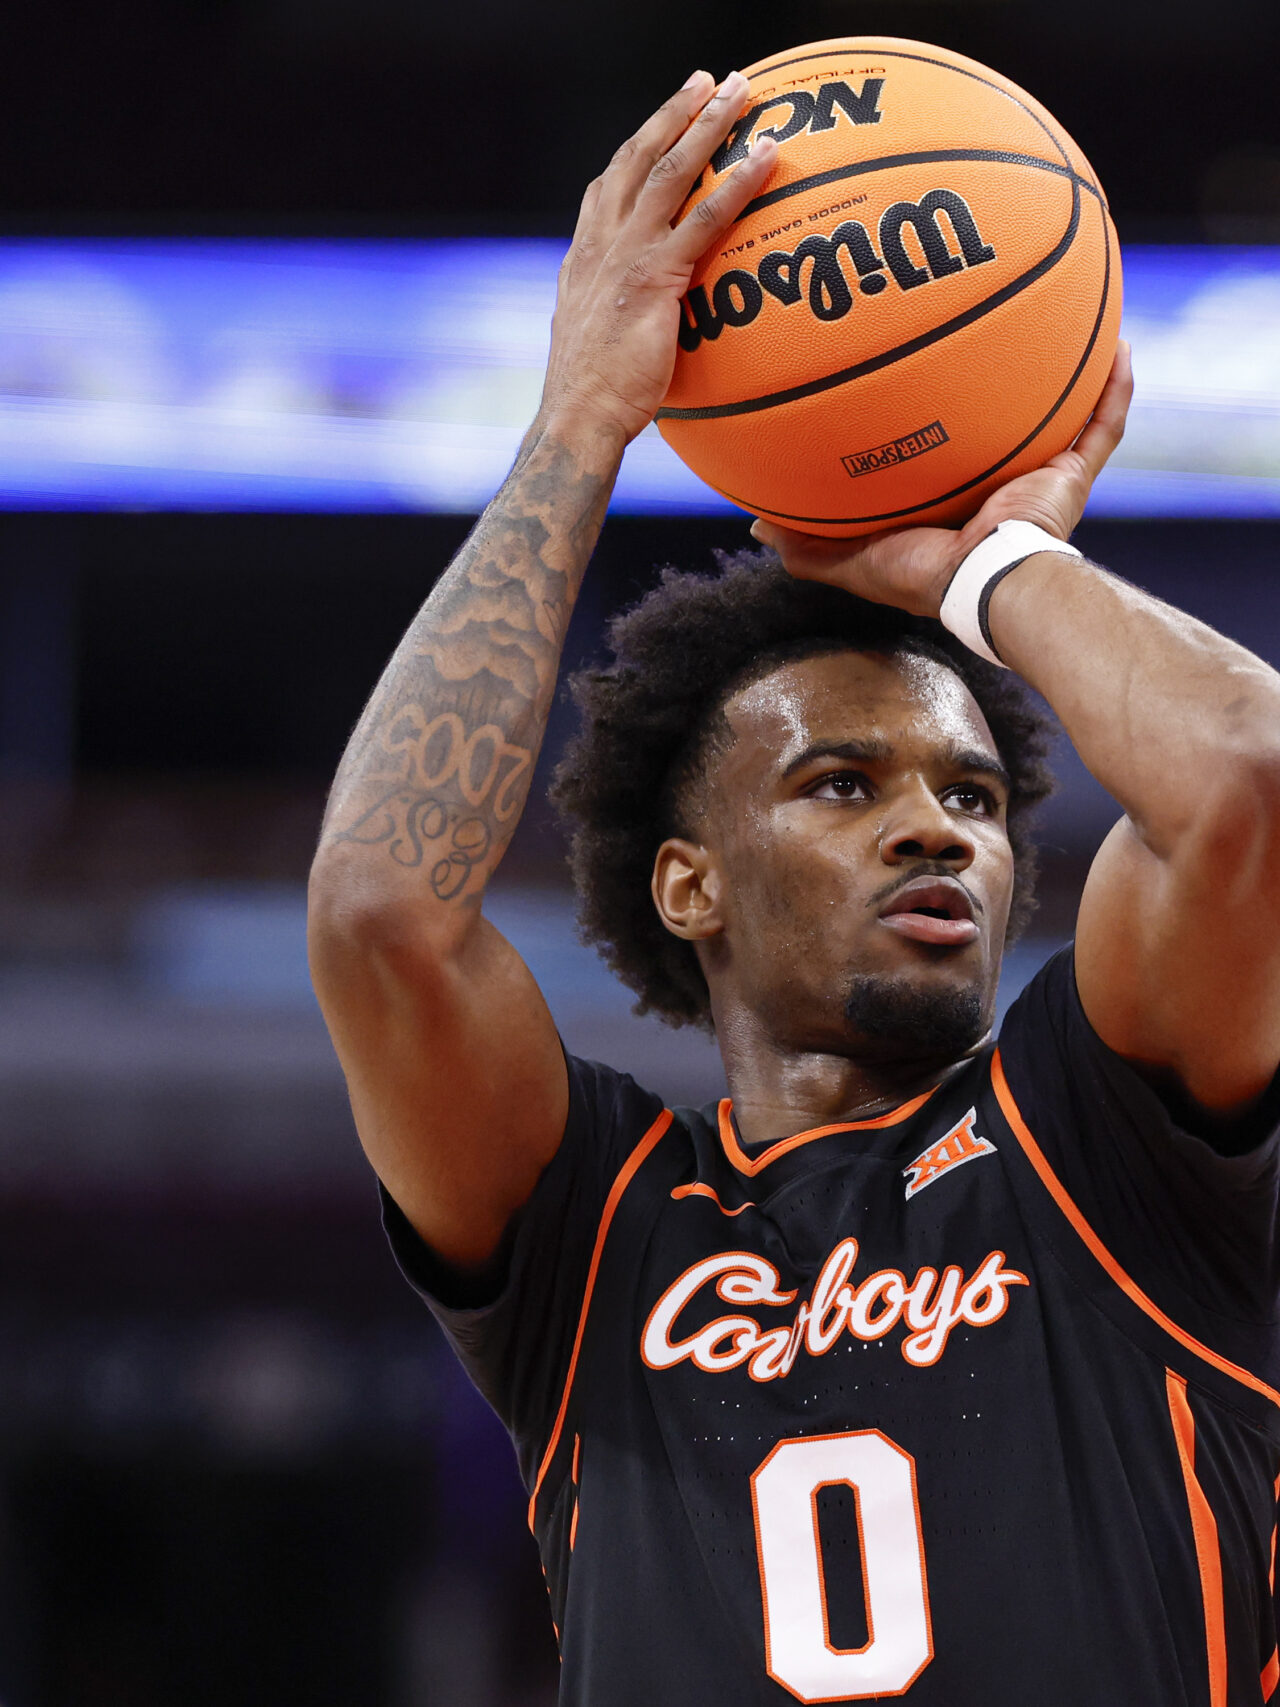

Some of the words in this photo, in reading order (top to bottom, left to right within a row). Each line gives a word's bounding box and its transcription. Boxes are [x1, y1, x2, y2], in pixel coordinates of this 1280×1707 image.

[782, 67, 887, 87] OFFICIAL
[690, 78, 887, 190] NCA
[720, 239, 756, 259] BALL
[759, 218, 803, 243] GAME
[806, 193, 869, 222] INDOOR
[677, 188, 997, 352] Wilson
[361, 703, 532, 822] 2005
[904, 1110, 992, 1195] XII
[750, 1428, 934, 1705] 0
